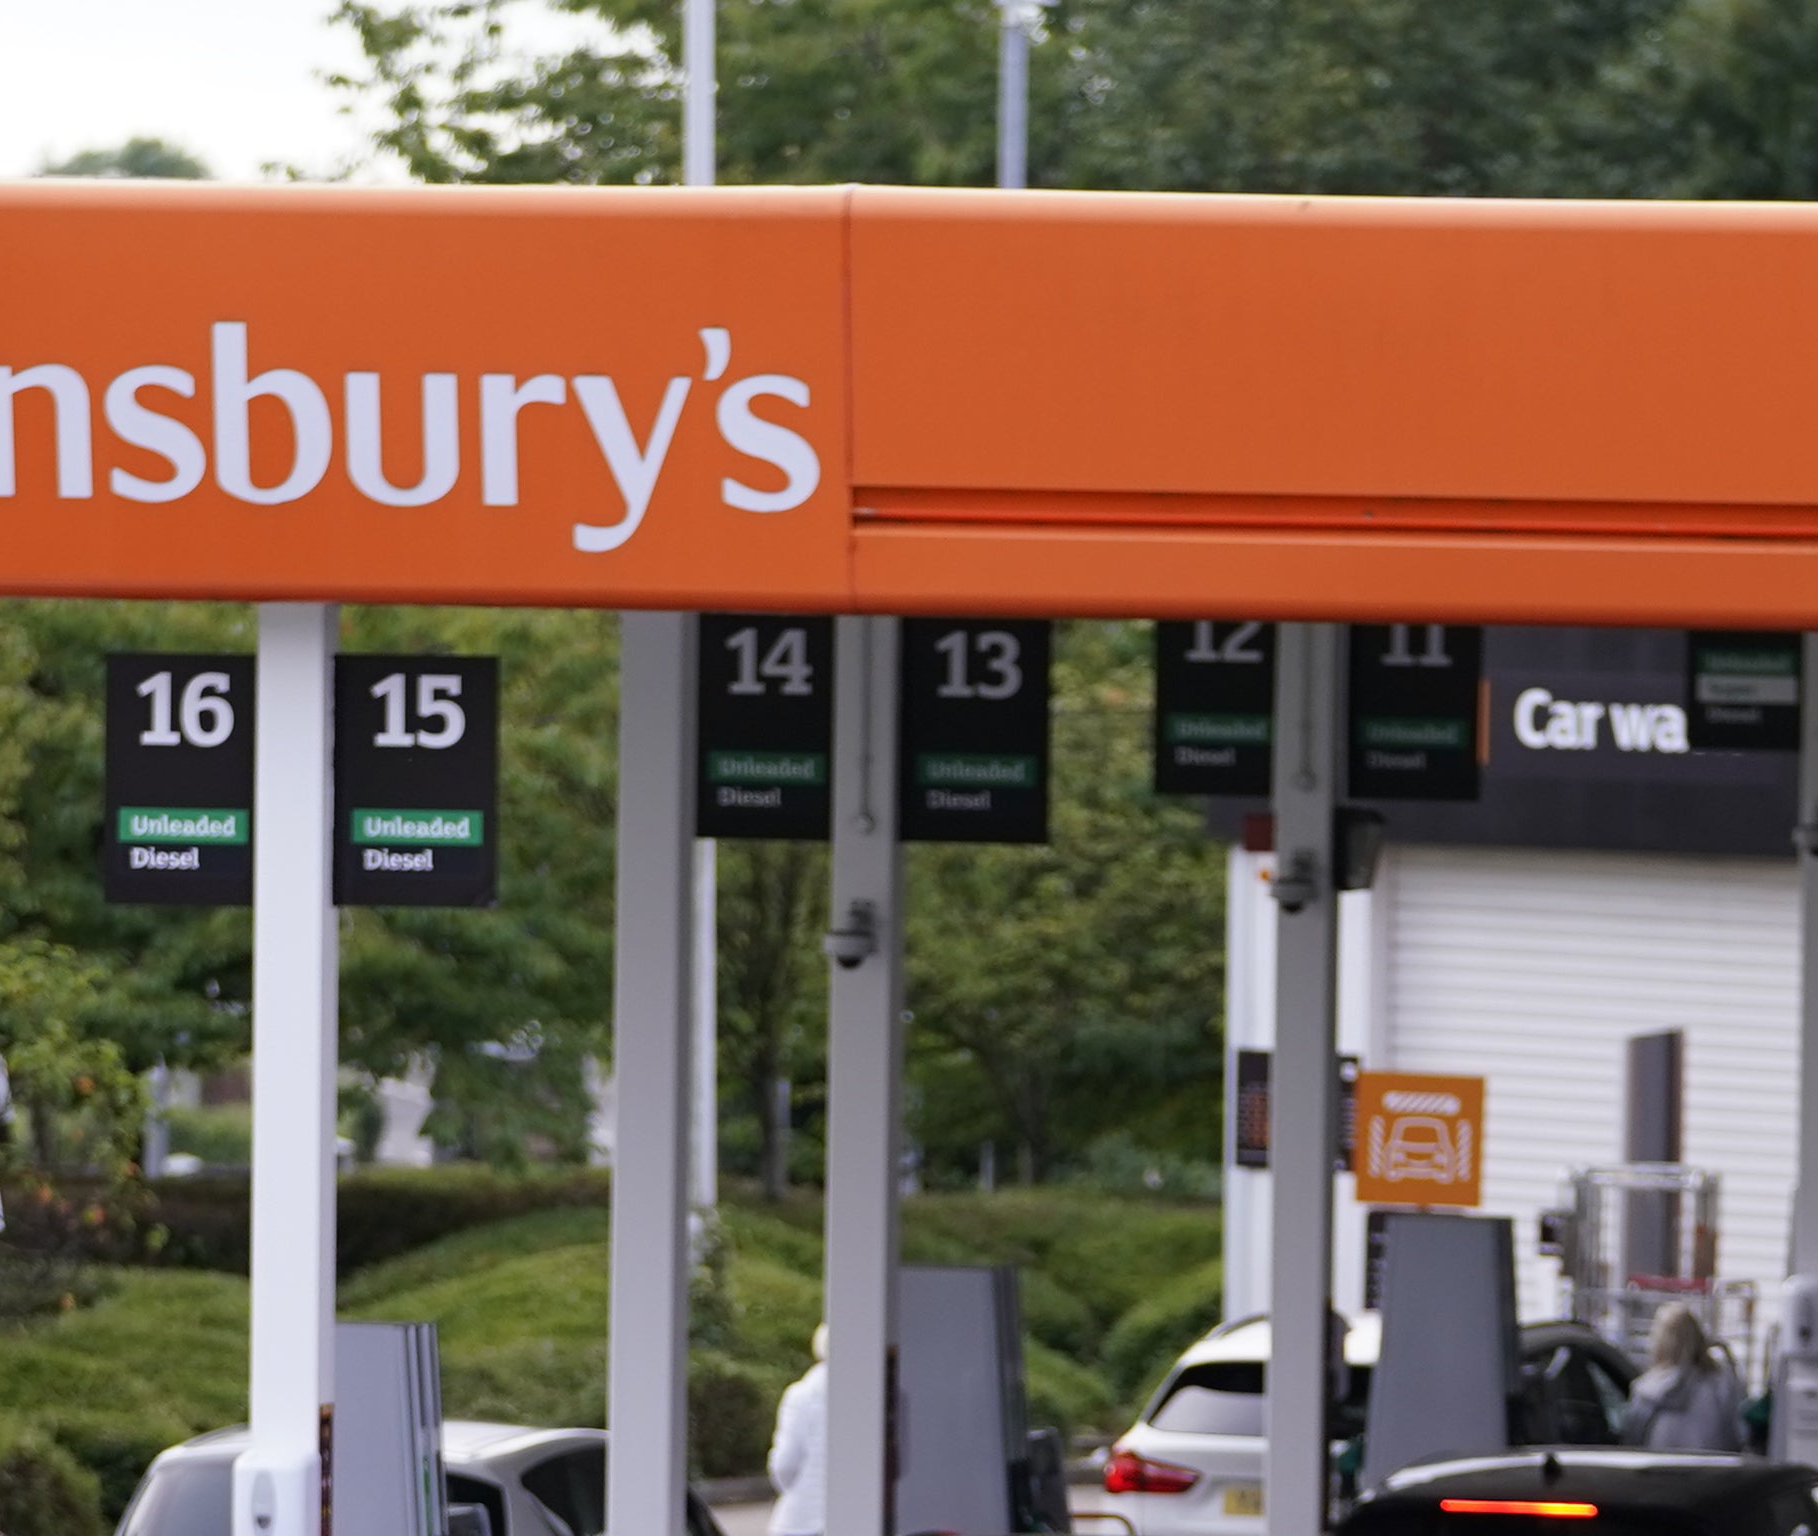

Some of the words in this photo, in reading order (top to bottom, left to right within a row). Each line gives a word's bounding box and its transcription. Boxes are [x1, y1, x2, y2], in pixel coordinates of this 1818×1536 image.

[1184, 620, 1264, 663] 12
[1380, 623, 1453, 666] 11
[724, 627, 814, 695] 14
[933, 630, 1024, 699] 13
[135, 671, 235, 748] 16
[369, 673, 467, 750] 15
[1513, 687, 1603, 750] Car
[717, 757, 817, 778] Unleaded
[925, 761, 1027, 782] Unleaded
[716, 786, 782, 807] Diesel
[925, 790, 993, 810] Diesel
[130, 814, 237, 838] Unleaded
[363, 816, 472, 840] Unleaded
[129, 846, 201, 871] Diesel
[363, 848, 434, 873] Diesel
